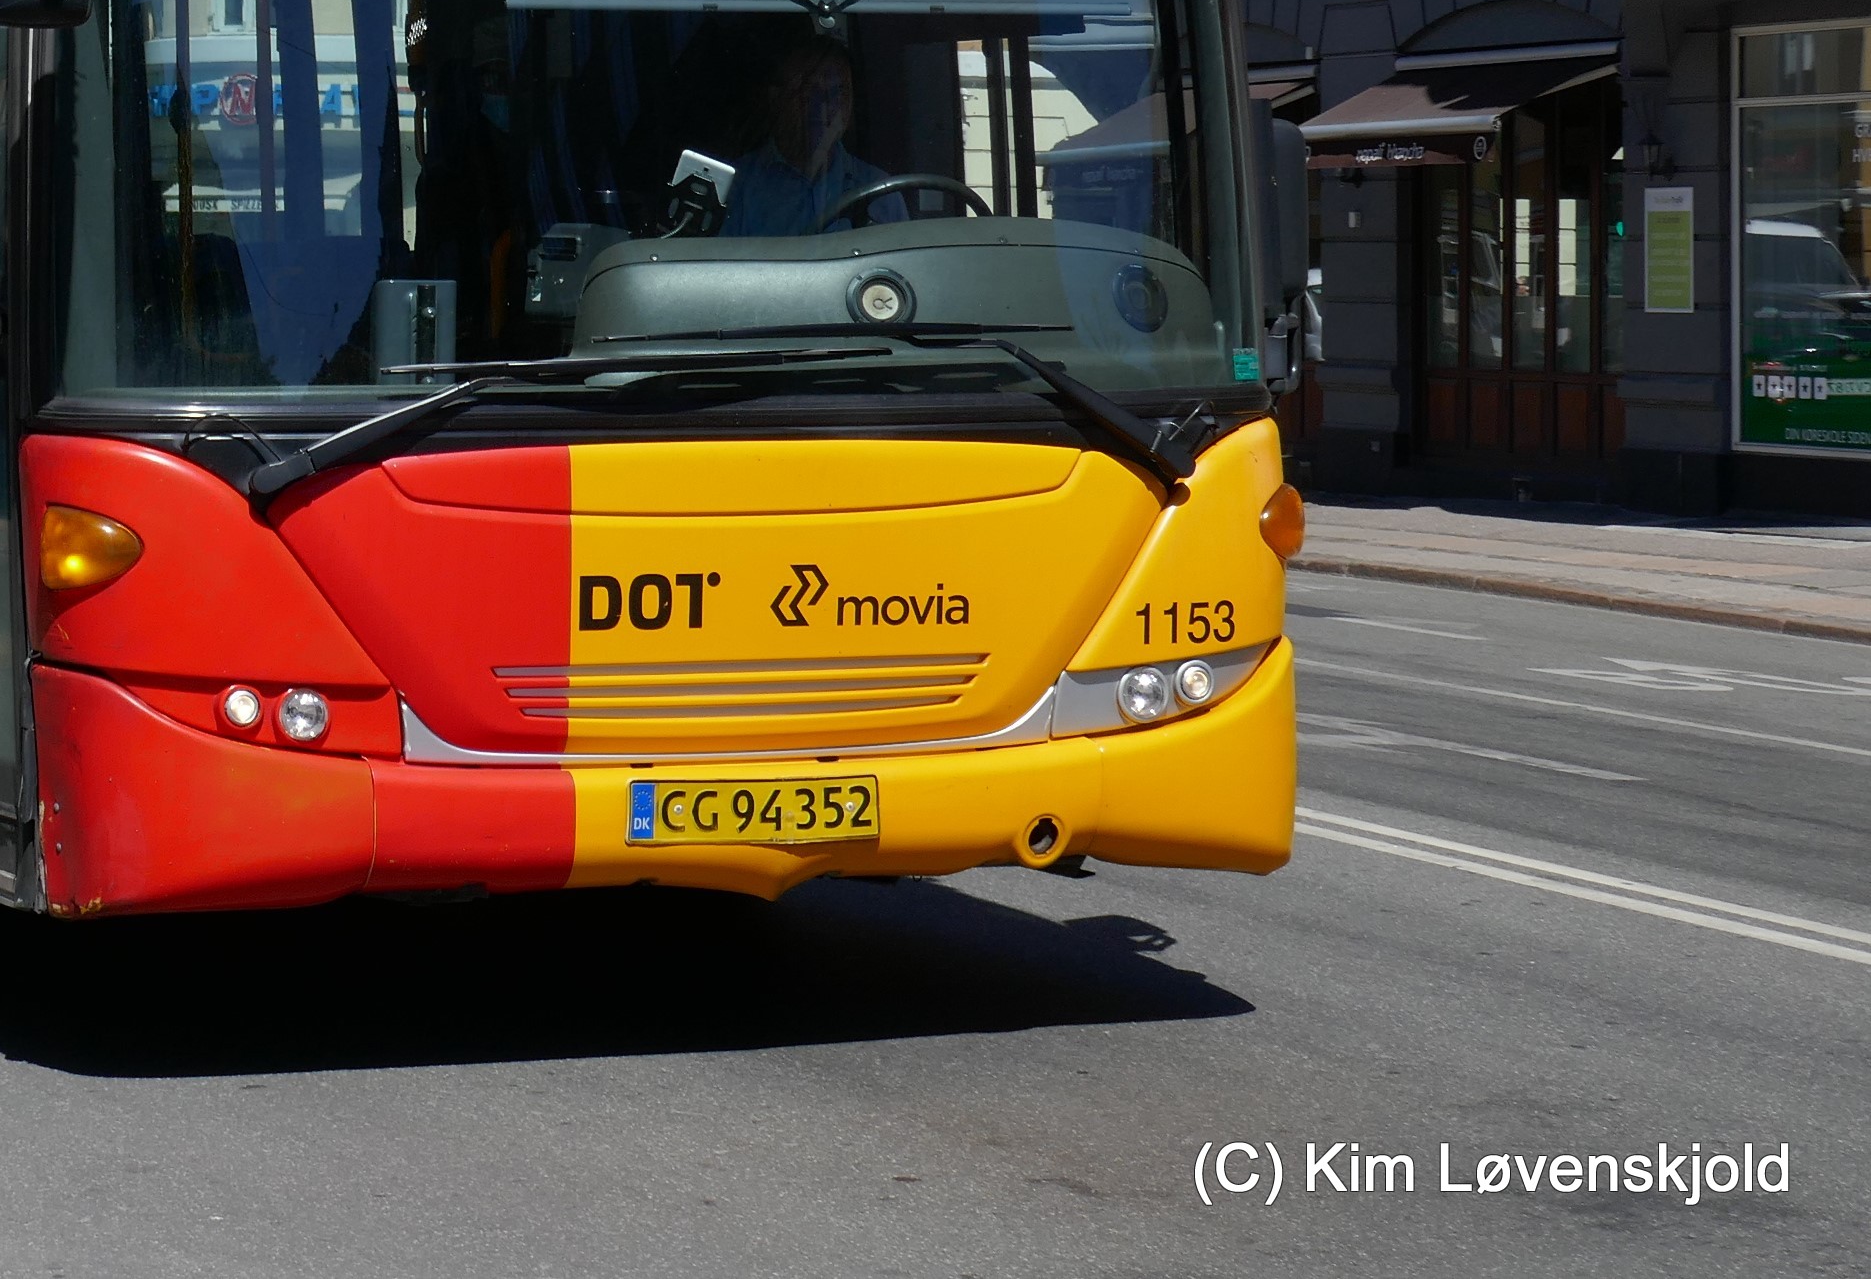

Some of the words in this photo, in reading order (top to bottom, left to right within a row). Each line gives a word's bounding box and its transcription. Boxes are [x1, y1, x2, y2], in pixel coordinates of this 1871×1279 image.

[578, 570, 722, 632] DOT
[836, 583, 970, 626] movia
[1135, 600, 1237, 646] 1153
[633, 816, 651, 830] DK
